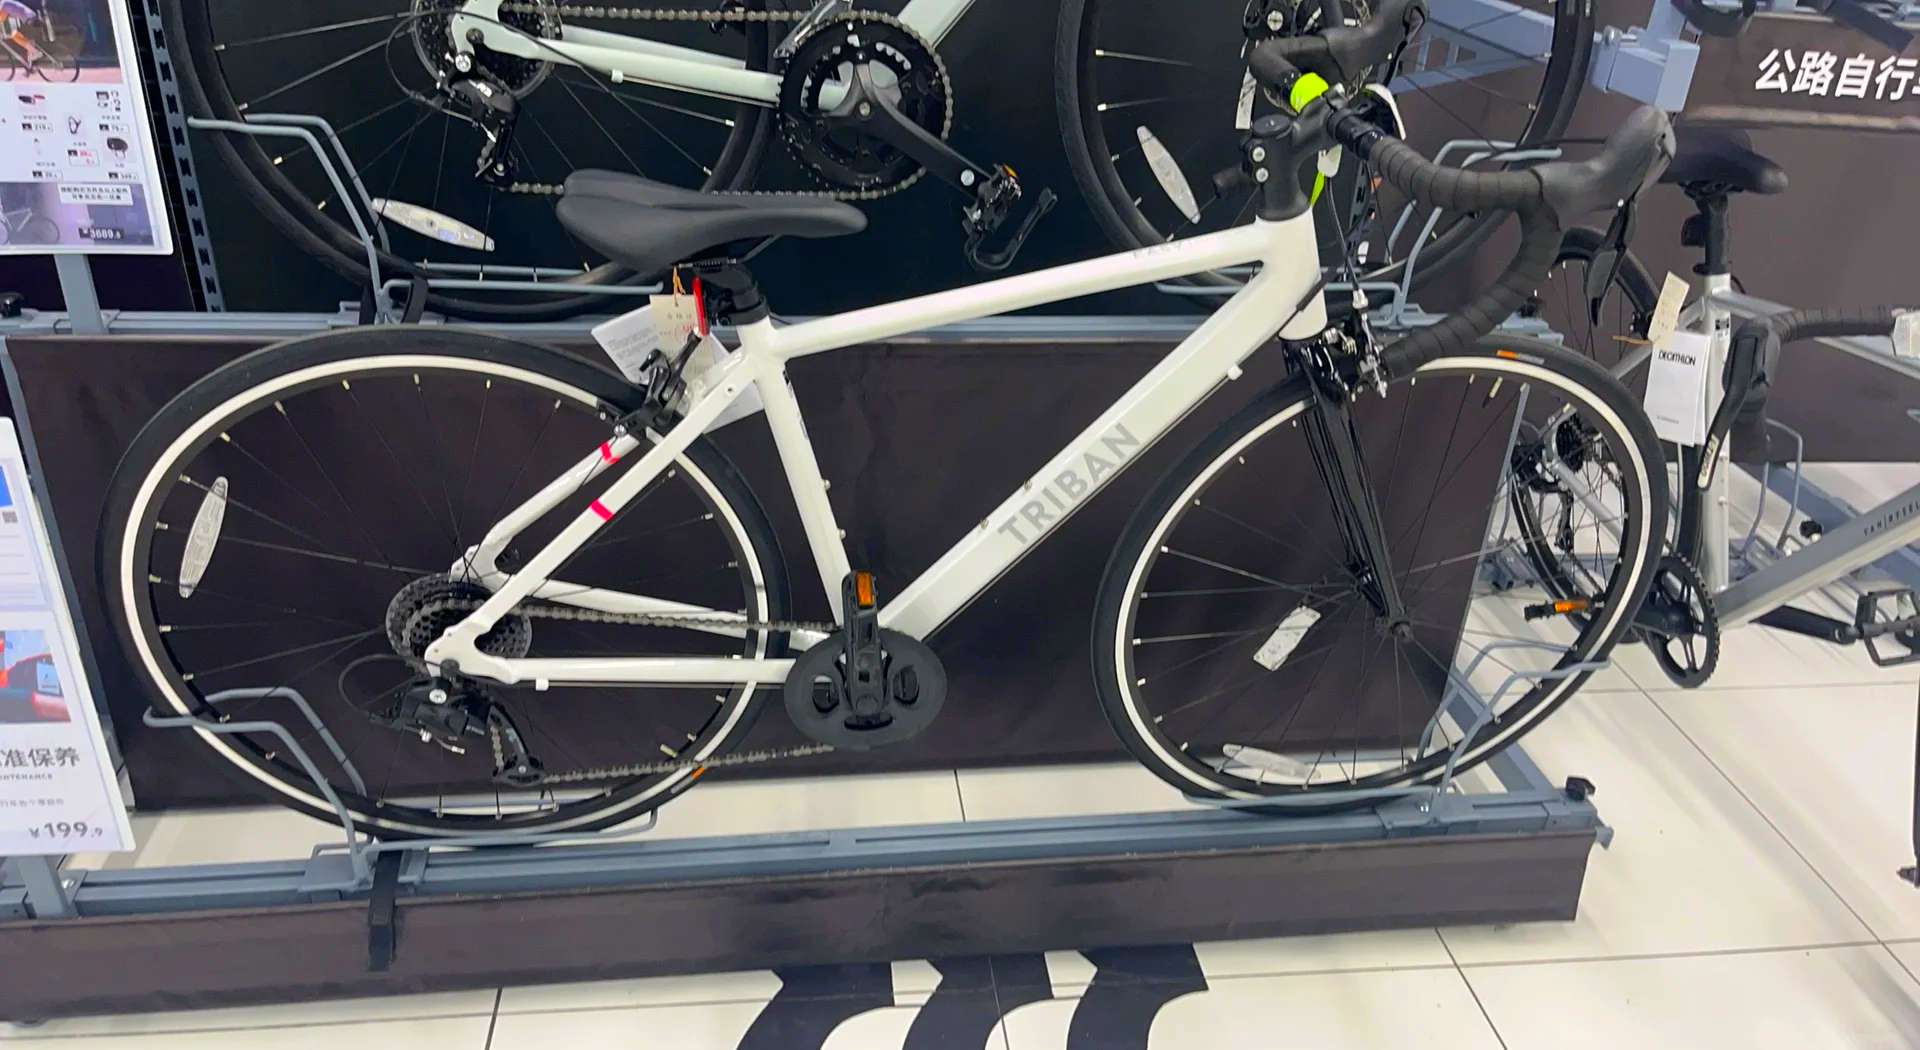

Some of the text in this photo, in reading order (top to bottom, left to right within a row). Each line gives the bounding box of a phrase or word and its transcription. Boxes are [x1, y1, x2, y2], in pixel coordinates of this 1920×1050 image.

[1755, 48, 1920, 100] 公路自行
[1658, 350, 1696, 366] DECATHLON
[997, 422, 1140, 546] TRIBAN
